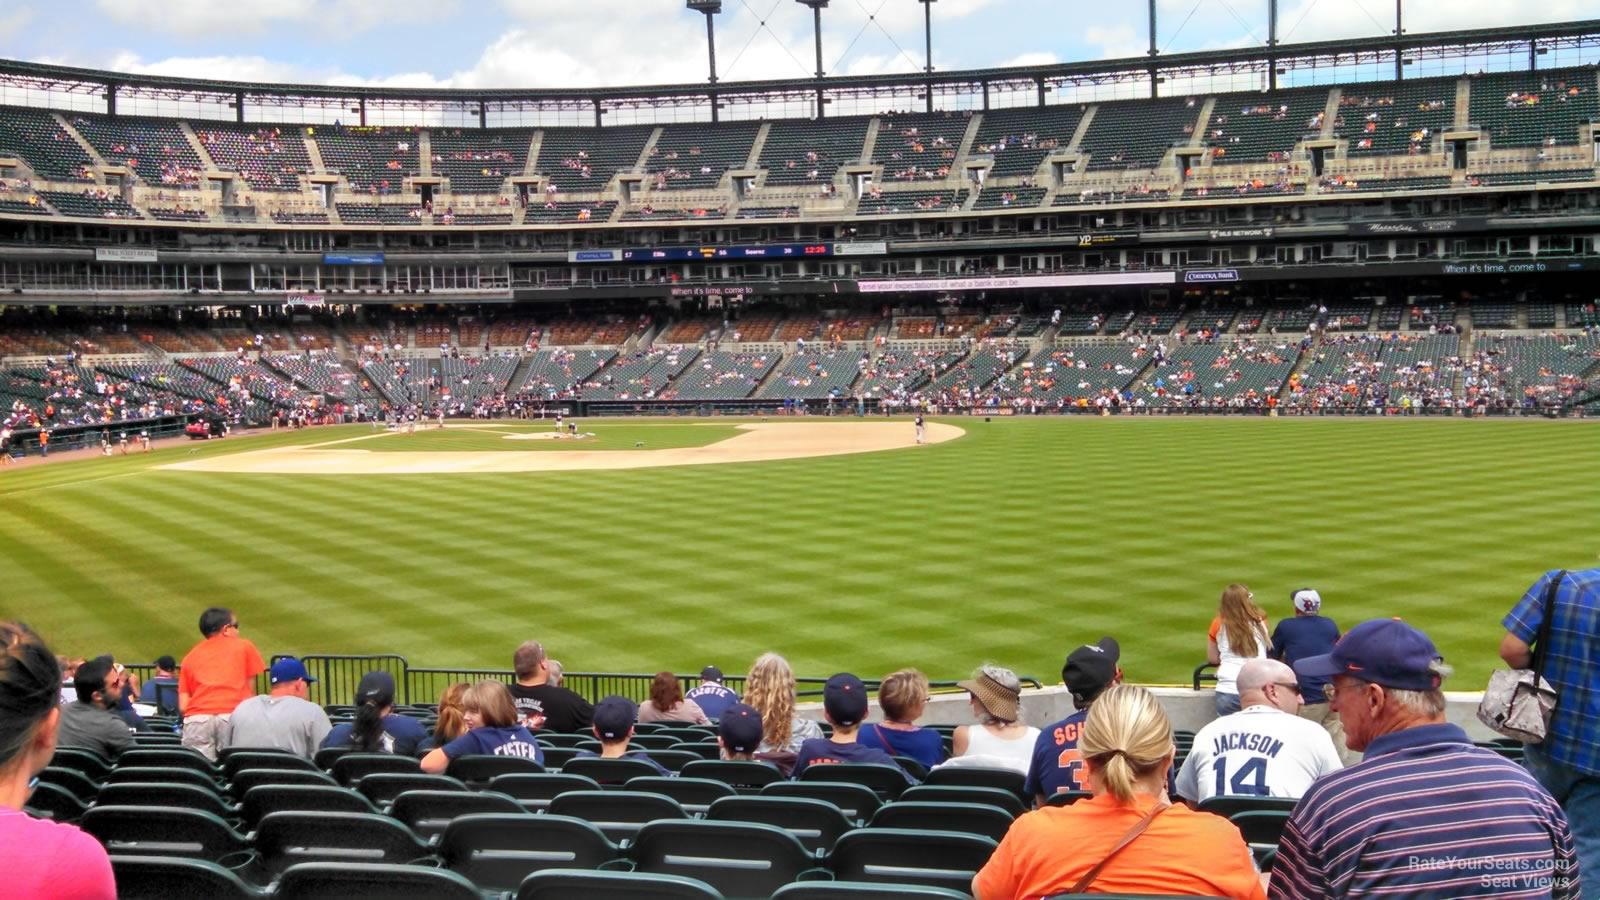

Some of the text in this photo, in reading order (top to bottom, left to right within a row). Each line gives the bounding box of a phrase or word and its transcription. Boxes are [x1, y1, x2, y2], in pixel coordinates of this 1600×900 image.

[1079, 235, 1092, 244] yp
[1442, 263, 1467, 273] When
[1469, 263, 1482, 273] it's
[1508, 262, 1535, 272] come
[1536, 262, 1546, 271] to
[974, 279, 992, 288] bank
[671, 287, 692, 296] When
[745, 285, 753, 294] to
[1212, 732, 1284, 759] JACKSON
[1212, 756, 1270, 797] 14
